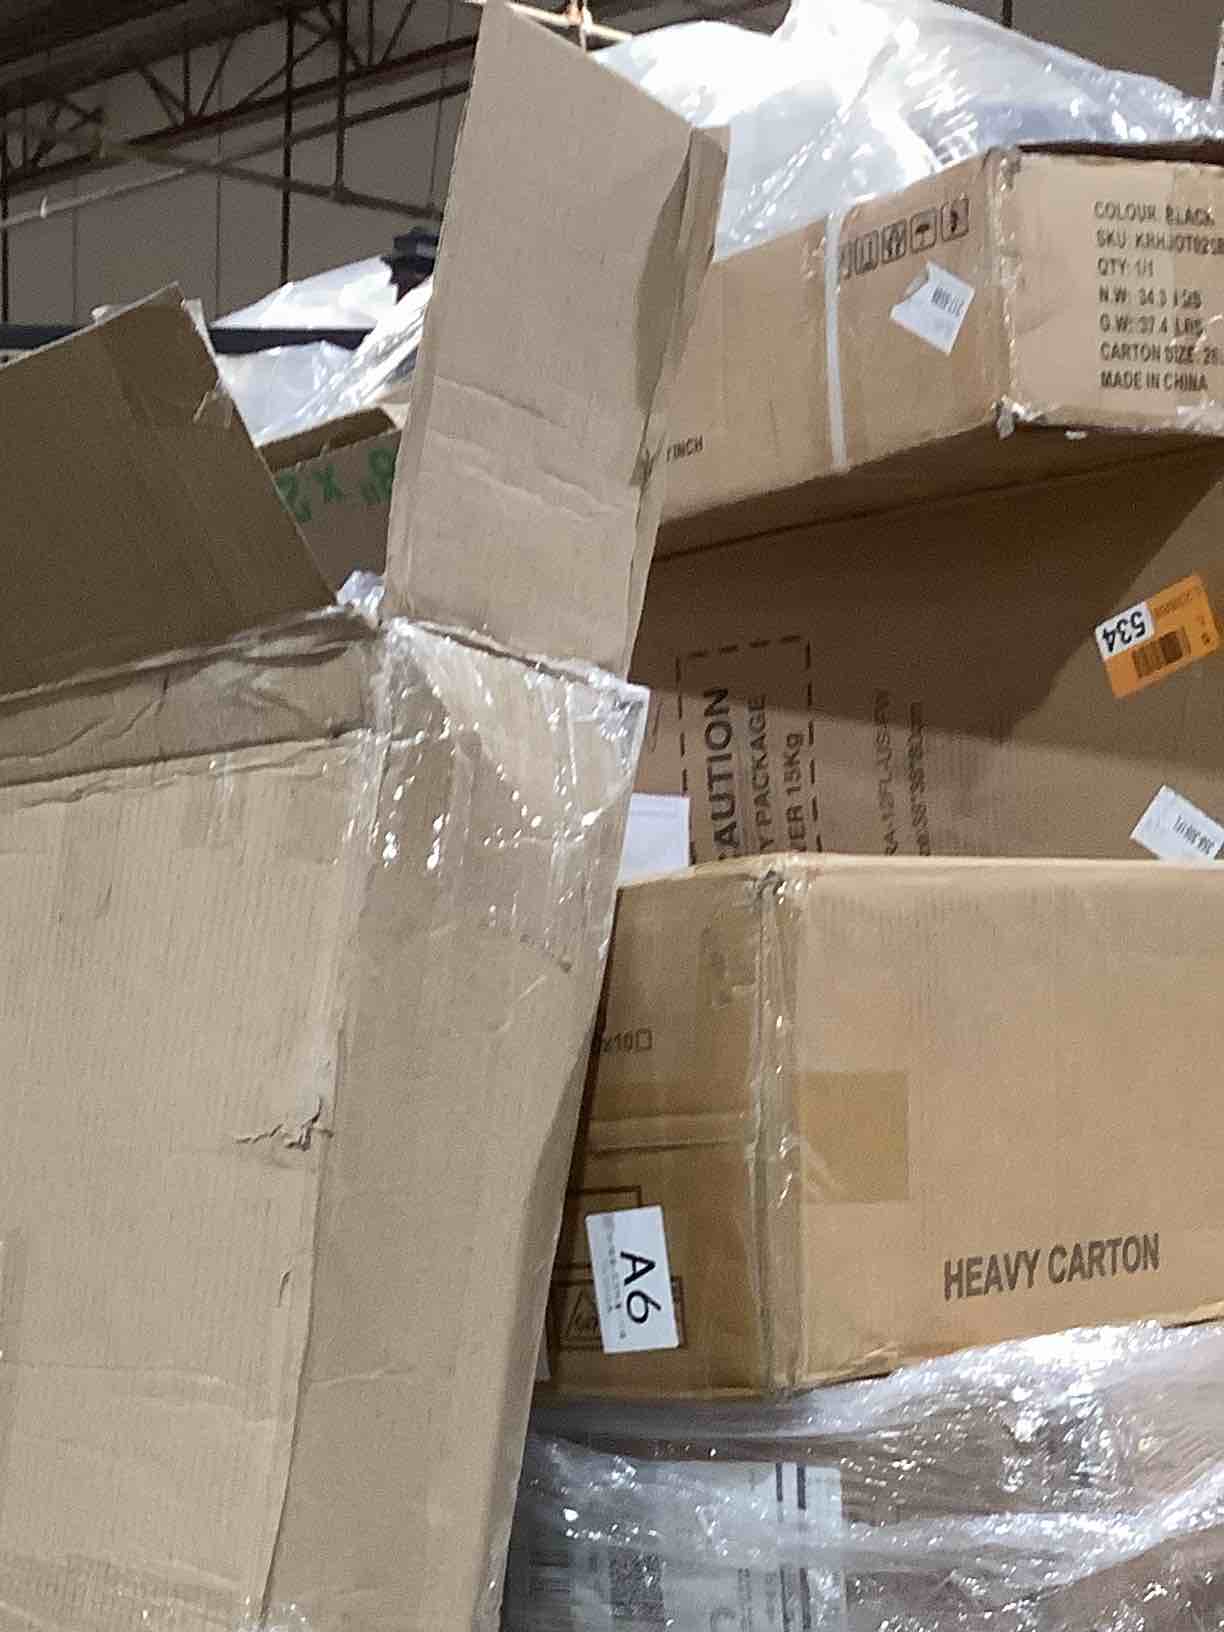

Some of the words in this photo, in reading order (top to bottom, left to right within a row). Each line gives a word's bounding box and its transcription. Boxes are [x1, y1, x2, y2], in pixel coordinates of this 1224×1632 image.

[1165, 205, 1215, 226] BLACK
[1100, 341, 1161, 363] CARTON
[1101, 370, 1142, 390] MADE
[1147, 371, 1161, 390] IN
[1163, 371, 1209, 391] CHINA
[1101, 610, 1147, 653] 534
[704, 687, 739, 859] AUTION
[747, 695, 775, 829] PACKAGE
[620, 1249, 662, 1326] A6
[943, 1249, 1041, 1301] HEAVY
[1047, 1232, 1160, 1285] CARTON
